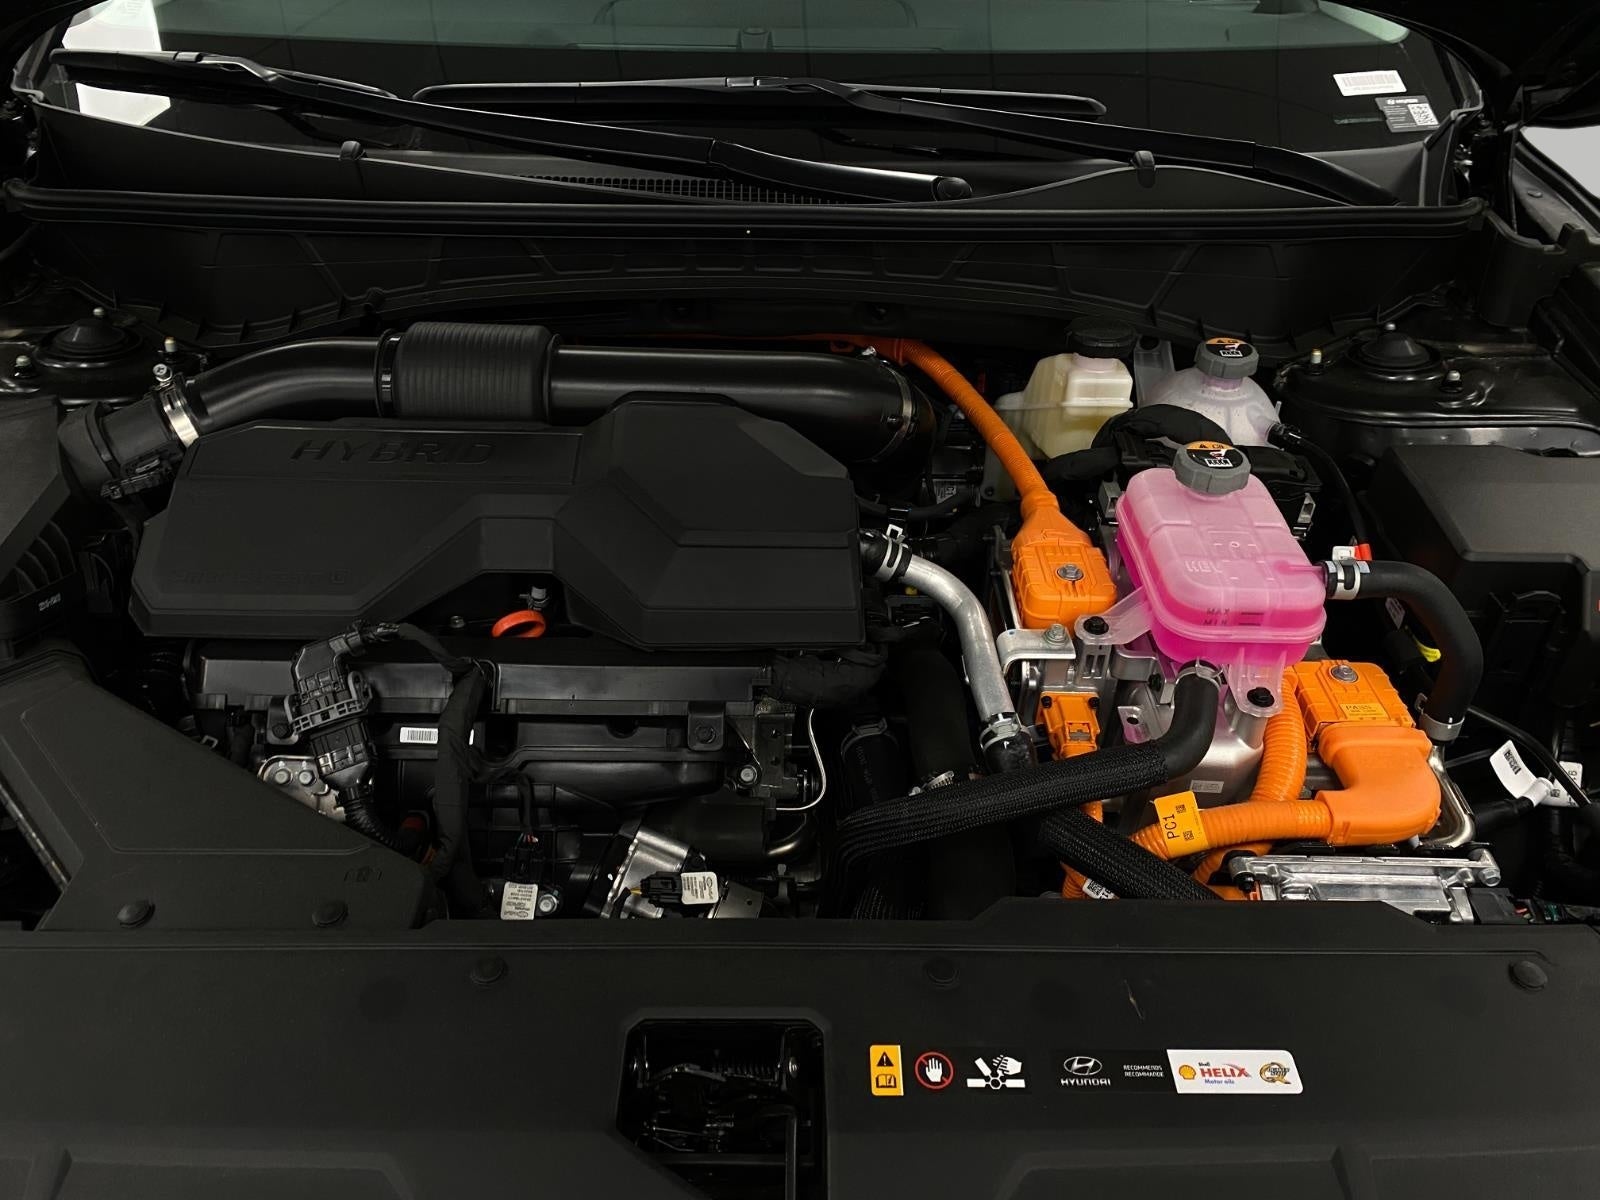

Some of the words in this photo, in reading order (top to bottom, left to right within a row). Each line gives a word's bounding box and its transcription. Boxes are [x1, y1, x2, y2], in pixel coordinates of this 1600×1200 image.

[289, 439, 496, 465] HYBRID
[1206, 608, 1230, 616] MAX
[1162, 813, 1180, 839] PC1
[1200, 1068, 1249, 1078] HELIX
[1060, 1078, 1112, 1086] HYUNDAI
